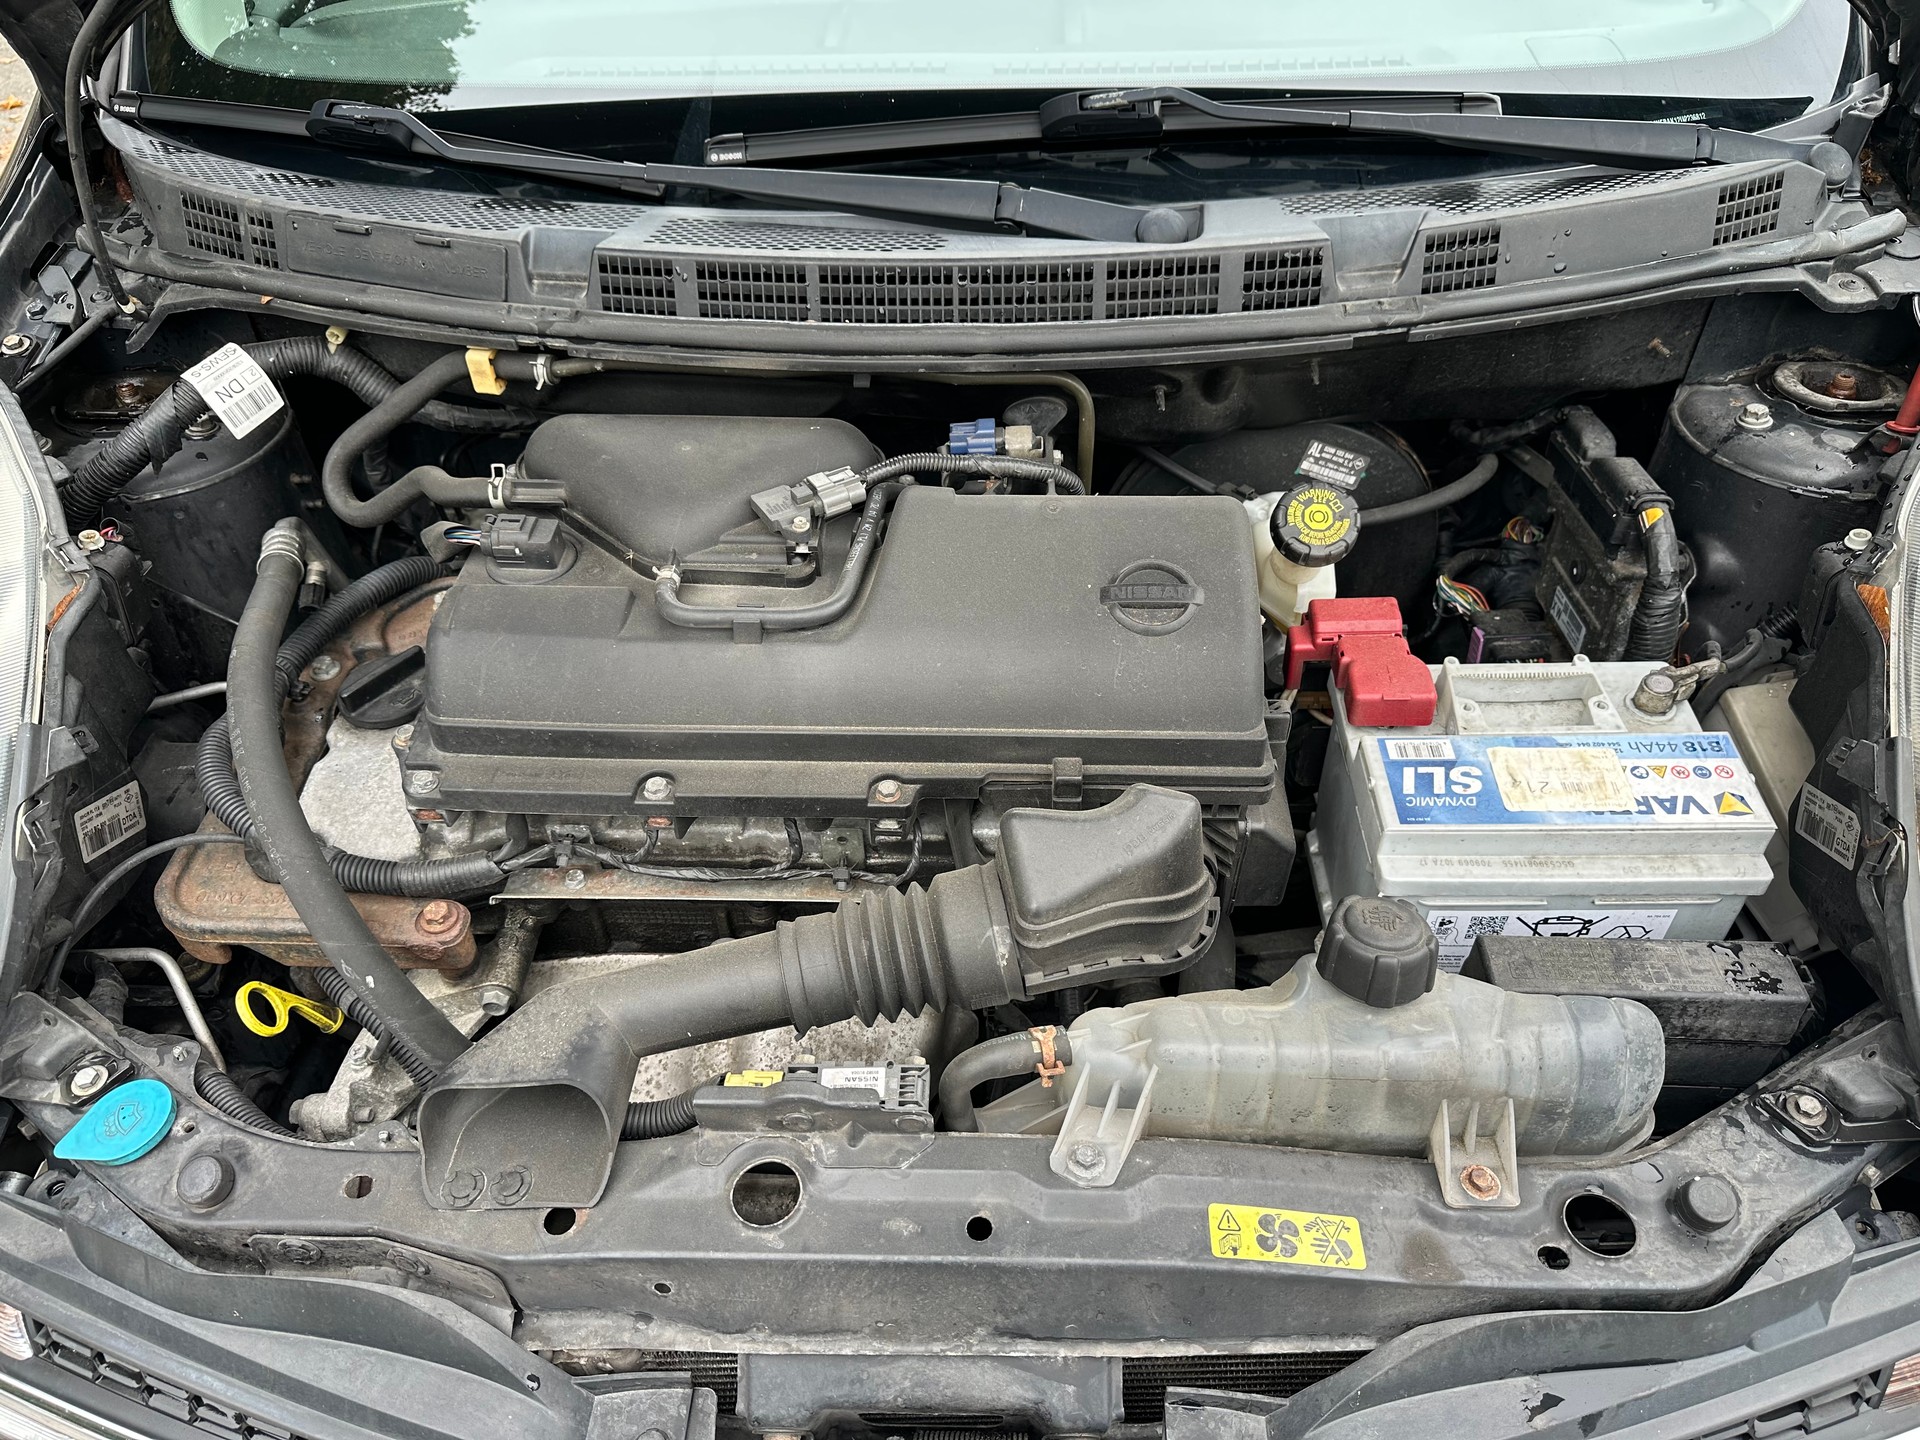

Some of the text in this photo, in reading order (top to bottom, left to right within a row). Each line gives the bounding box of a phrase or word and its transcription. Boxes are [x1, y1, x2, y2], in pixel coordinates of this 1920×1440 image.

[191, 346, 237, 378] SEWS-S
[214, 378, 245, 404] DN
[1308, 442, 1322, 457] AL
[1296, 489, 1336, 503] WARNING
[1110, 586, 1195, 599] NISSAN
[1628, 740, 1678, 753] 44Ah
[1683, 740, 1724, 753] B18
[1402, 766, 1483, 795] SLI
[1406, 796, 1477, 807] DYNAMIC
[1590, 795, 1711, 815] VAR
[122, 812, 137, 825] DTDA
[1836, 837, 1850, 853] GTDA
